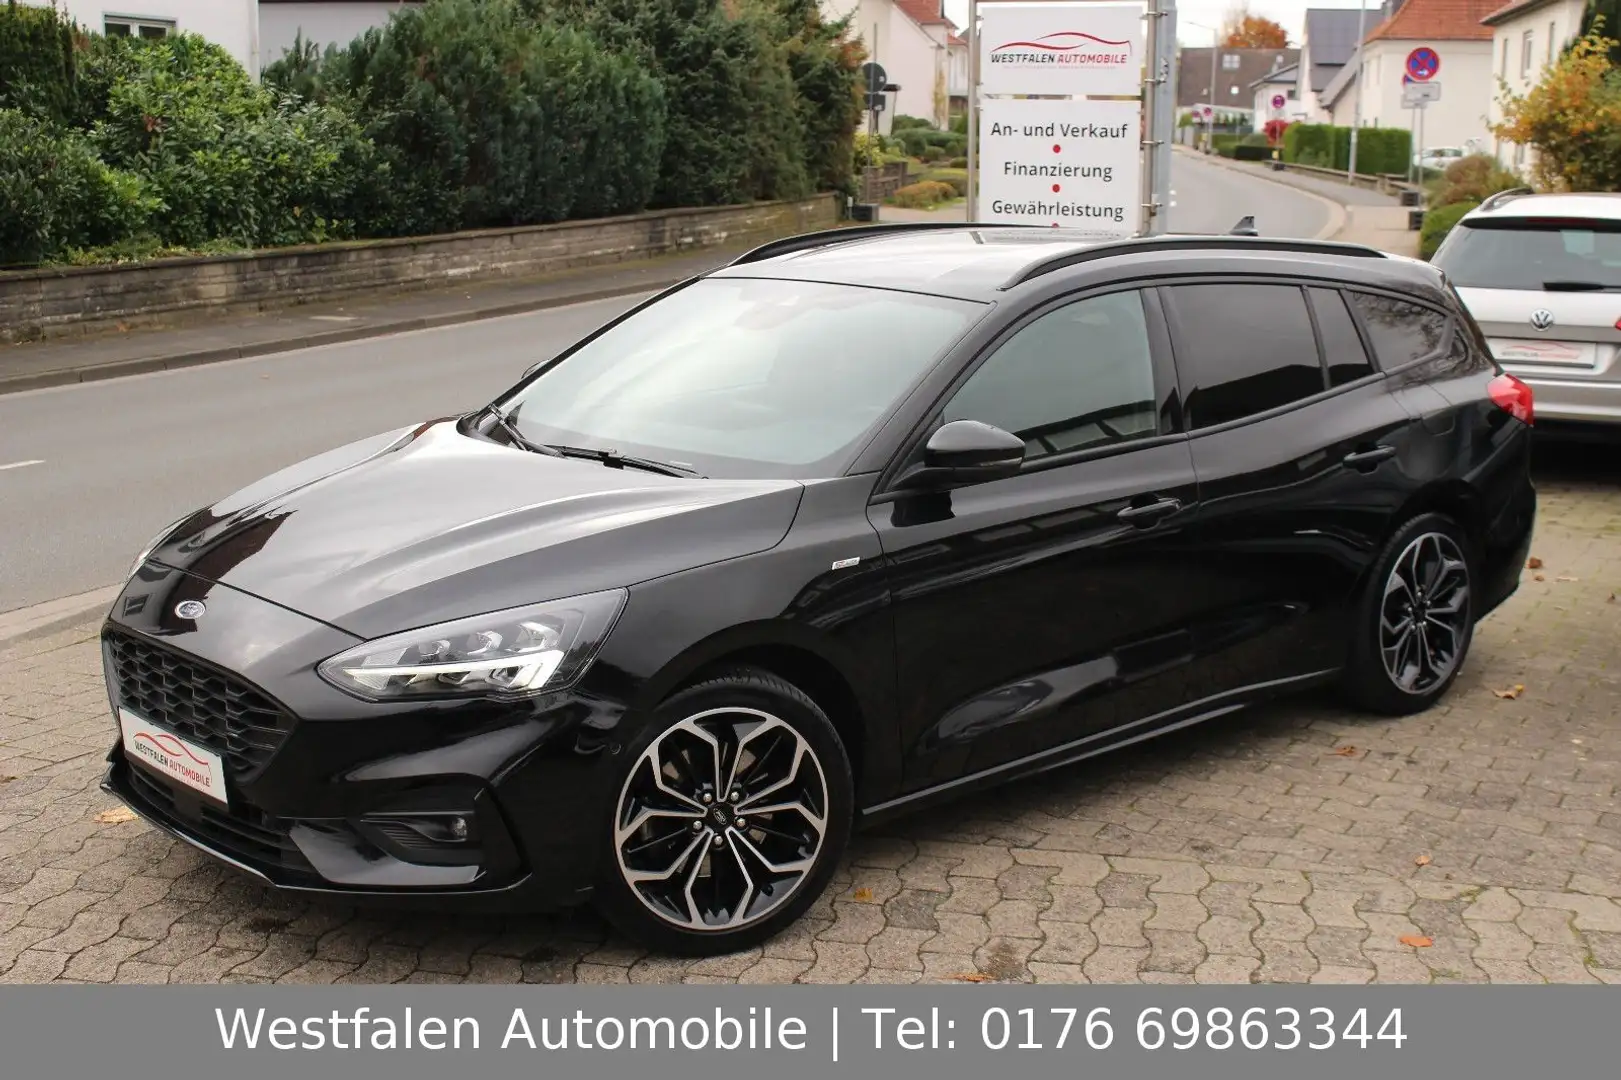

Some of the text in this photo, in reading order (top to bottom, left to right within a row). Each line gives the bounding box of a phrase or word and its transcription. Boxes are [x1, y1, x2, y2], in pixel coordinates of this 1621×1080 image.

[991, 53, 1127, 64] WESTFALEN AUTOMOBILE
[991, 122, 1128, 138] An- und Verkauf
[1004, 161, 1113, 182] Finanzierung
[992, 200, 1124, 222] Gewährleistung
[134, 741, 169, 767] WESTFALEN
[169, 759, 210, 788] AUTOMOBILE
